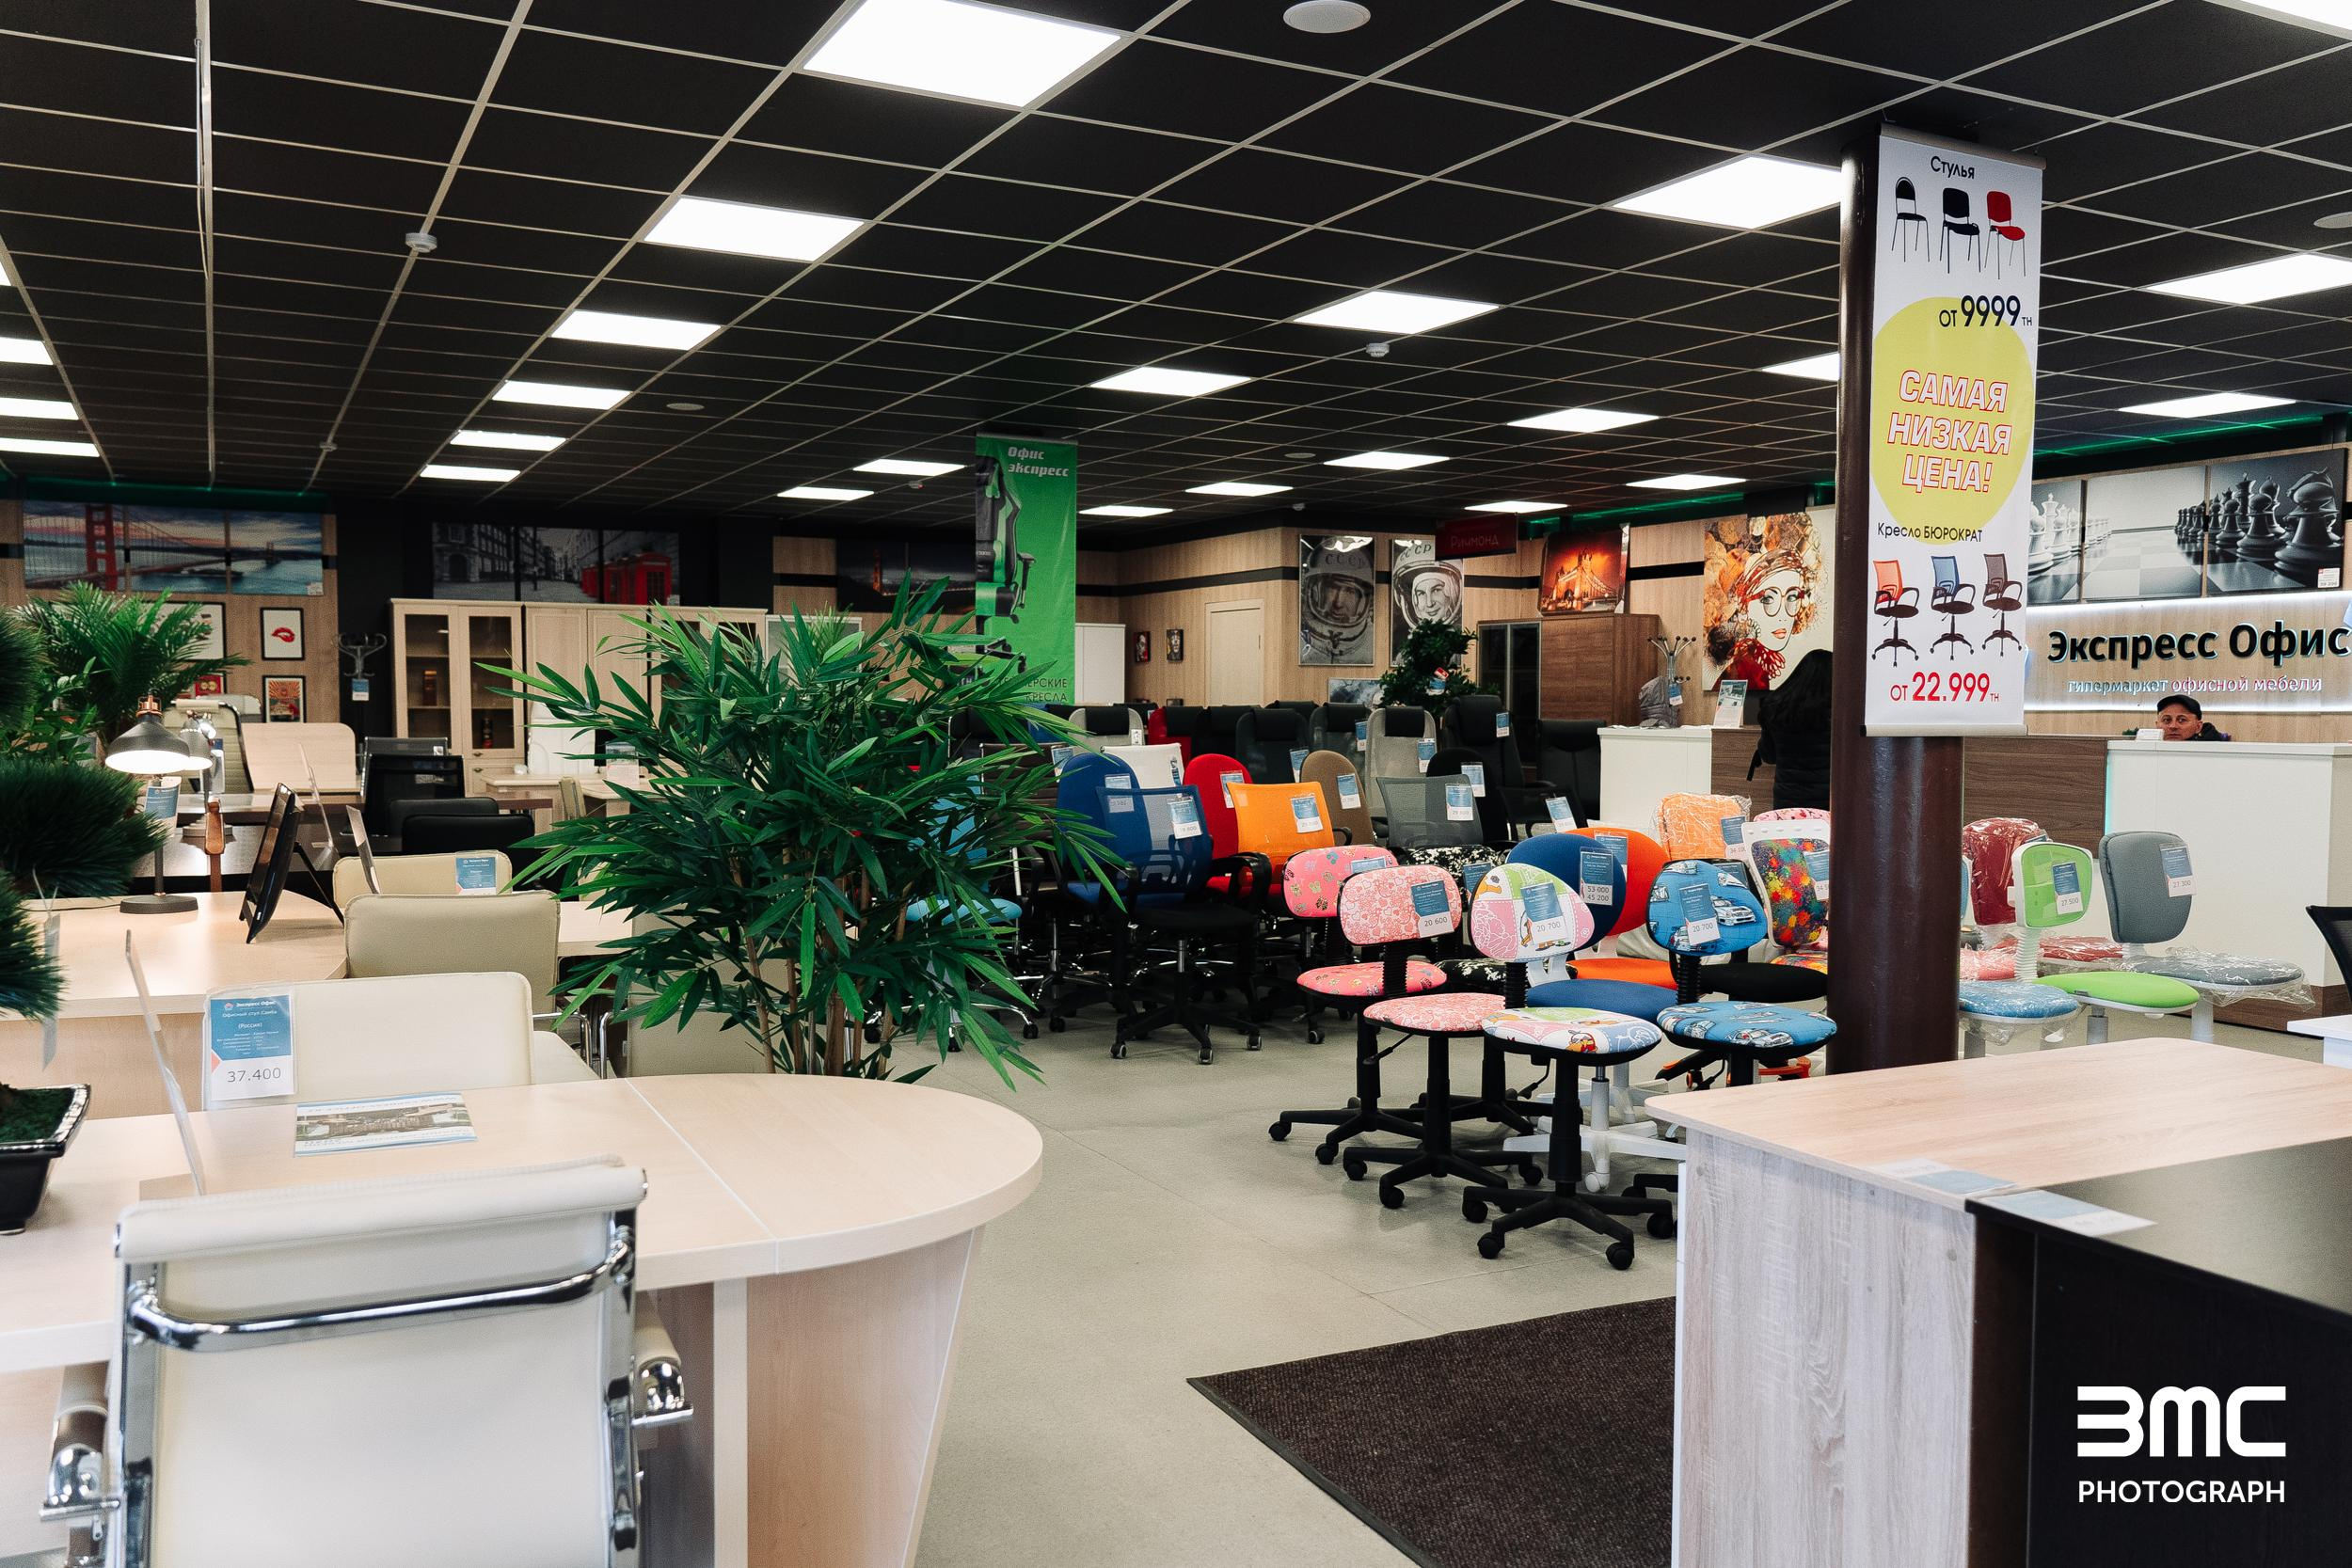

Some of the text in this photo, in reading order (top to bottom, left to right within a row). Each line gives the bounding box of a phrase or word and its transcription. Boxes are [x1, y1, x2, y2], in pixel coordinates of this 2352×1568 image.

[1931, 155, 1975, 180] Стулья
[1961, 294, 2021, 327] 9999
[1899, 370, 2010, 413] САМАЯ
[1887, 412, 2012, 455] НИЗКАЯ
[1008, 446, 1045, 461] Офис
[1008, 462, 1070, 478] экспресс
[1901, 453, 1994, 493] ЦЕНА!
[1877, 522, 1983, 543] Кресло БЮРОКРАТ
[2047, 619, 2352, 670] Экспресс Офис
[1912, 671, 1990, 702] 22.999
[2067, 675, 2323, 696] гипермаркет офисной мебели
[1423, 916, 1448, 927] 20 600
[227, 1067, 281, 1084] 37.400
